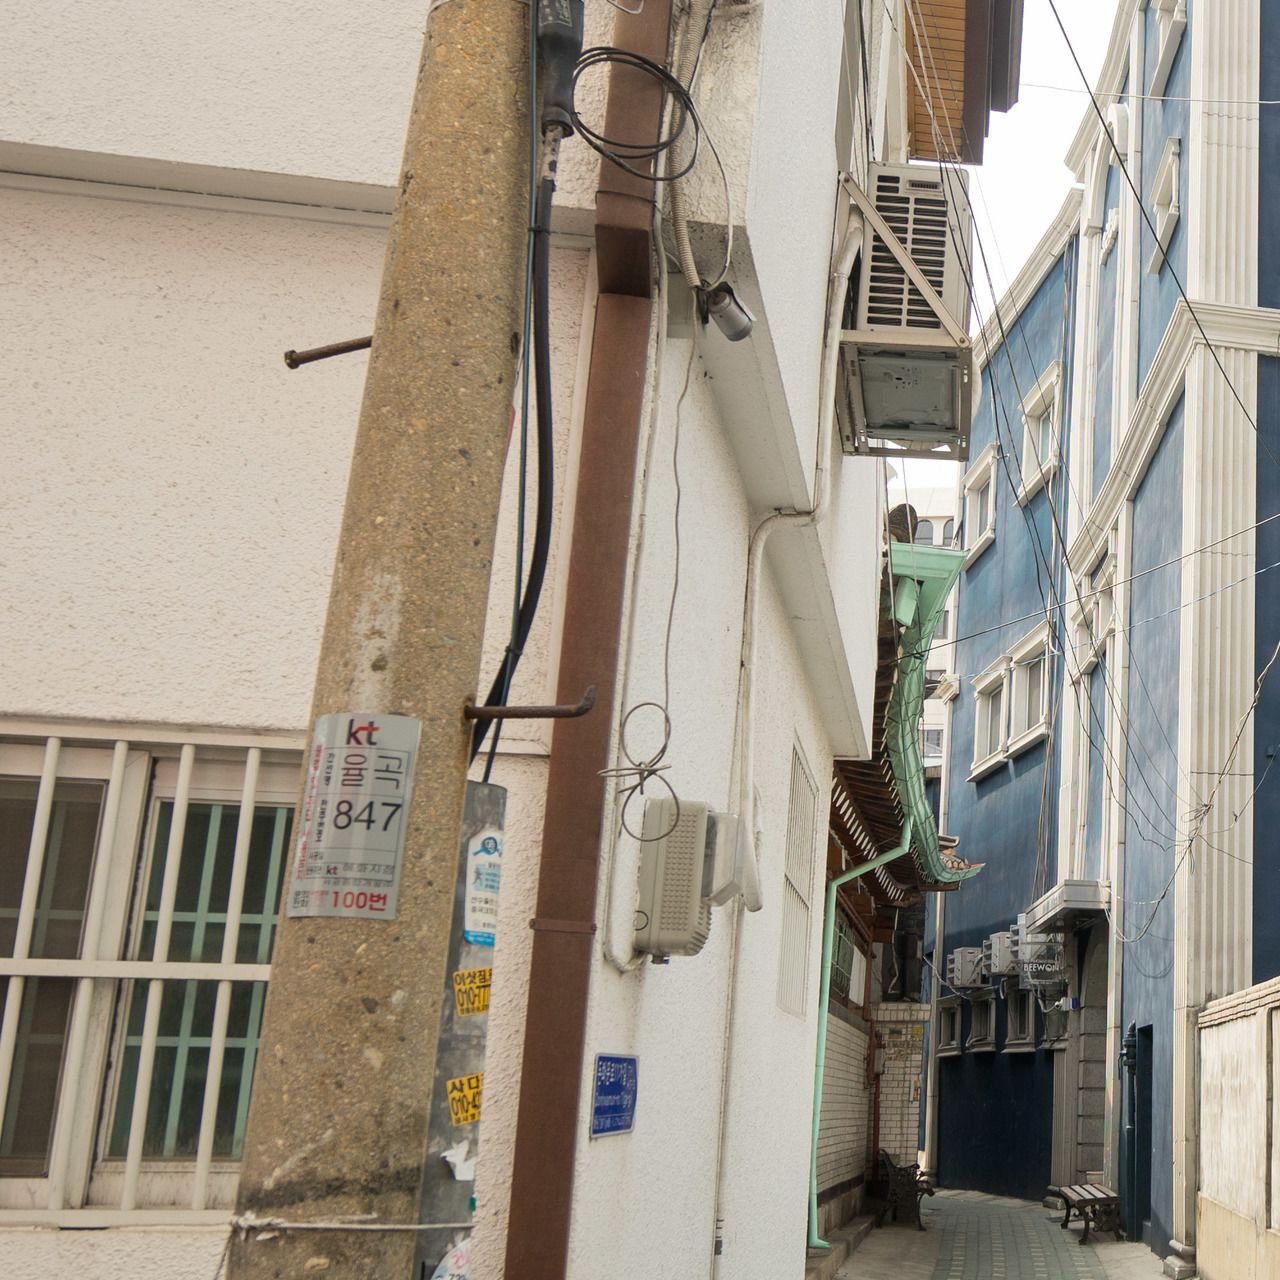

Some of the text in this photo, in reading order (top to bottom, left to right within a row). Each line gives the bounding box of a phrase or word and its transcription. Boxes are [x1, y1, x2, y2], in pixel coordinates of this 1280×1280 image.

[346, 718, 380, 745] kt
[333, 800, 402, 831] 847
[333, 891, 387, 912] 100번
